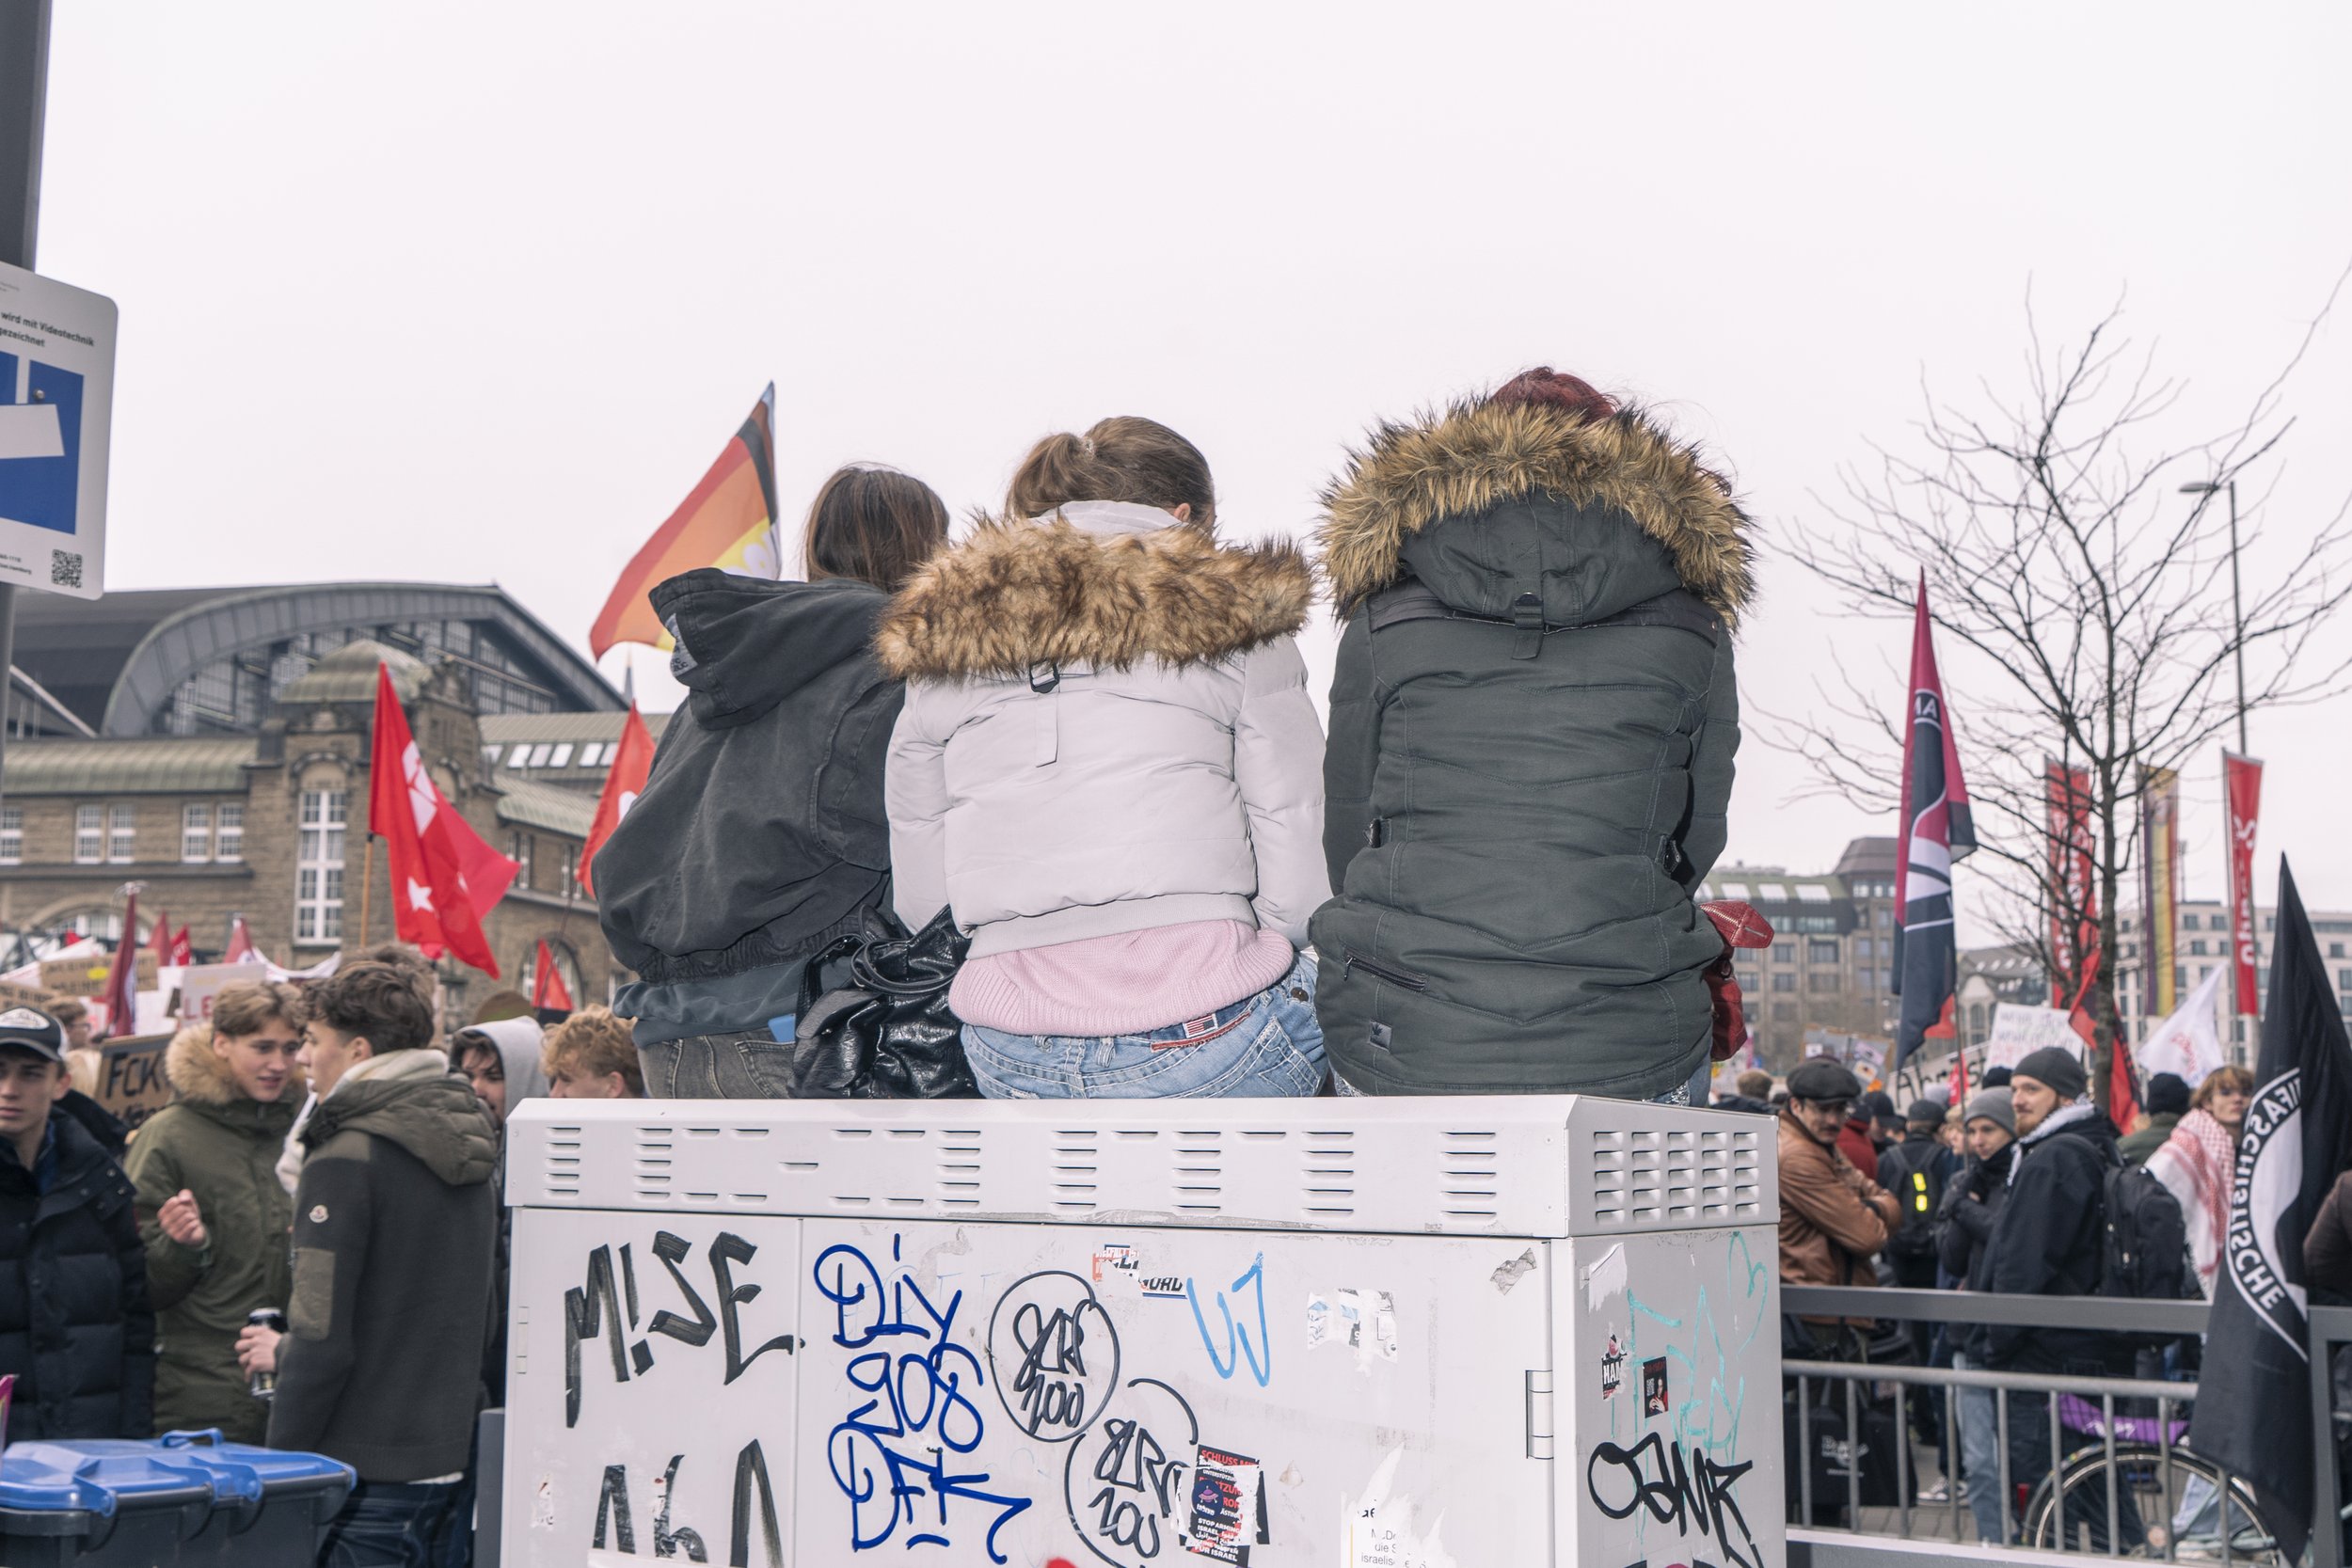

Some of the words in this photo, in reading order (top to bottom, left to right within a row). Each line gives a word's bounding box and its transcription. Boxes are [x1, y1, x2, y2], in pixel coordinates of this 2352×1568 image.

[1, 312, 21, 325] wird
[23, 318, 38, 329] mit
[39, 323, 94, 347] Videotechnik
[1198, 1517, 1216, 1528] STOP
[1197, 1524, 1219, 1536] ISRAEL
[1211, 1548, 1238, 1561] ISRAEL
[1360, 1552, 1395, 1566] israelis
